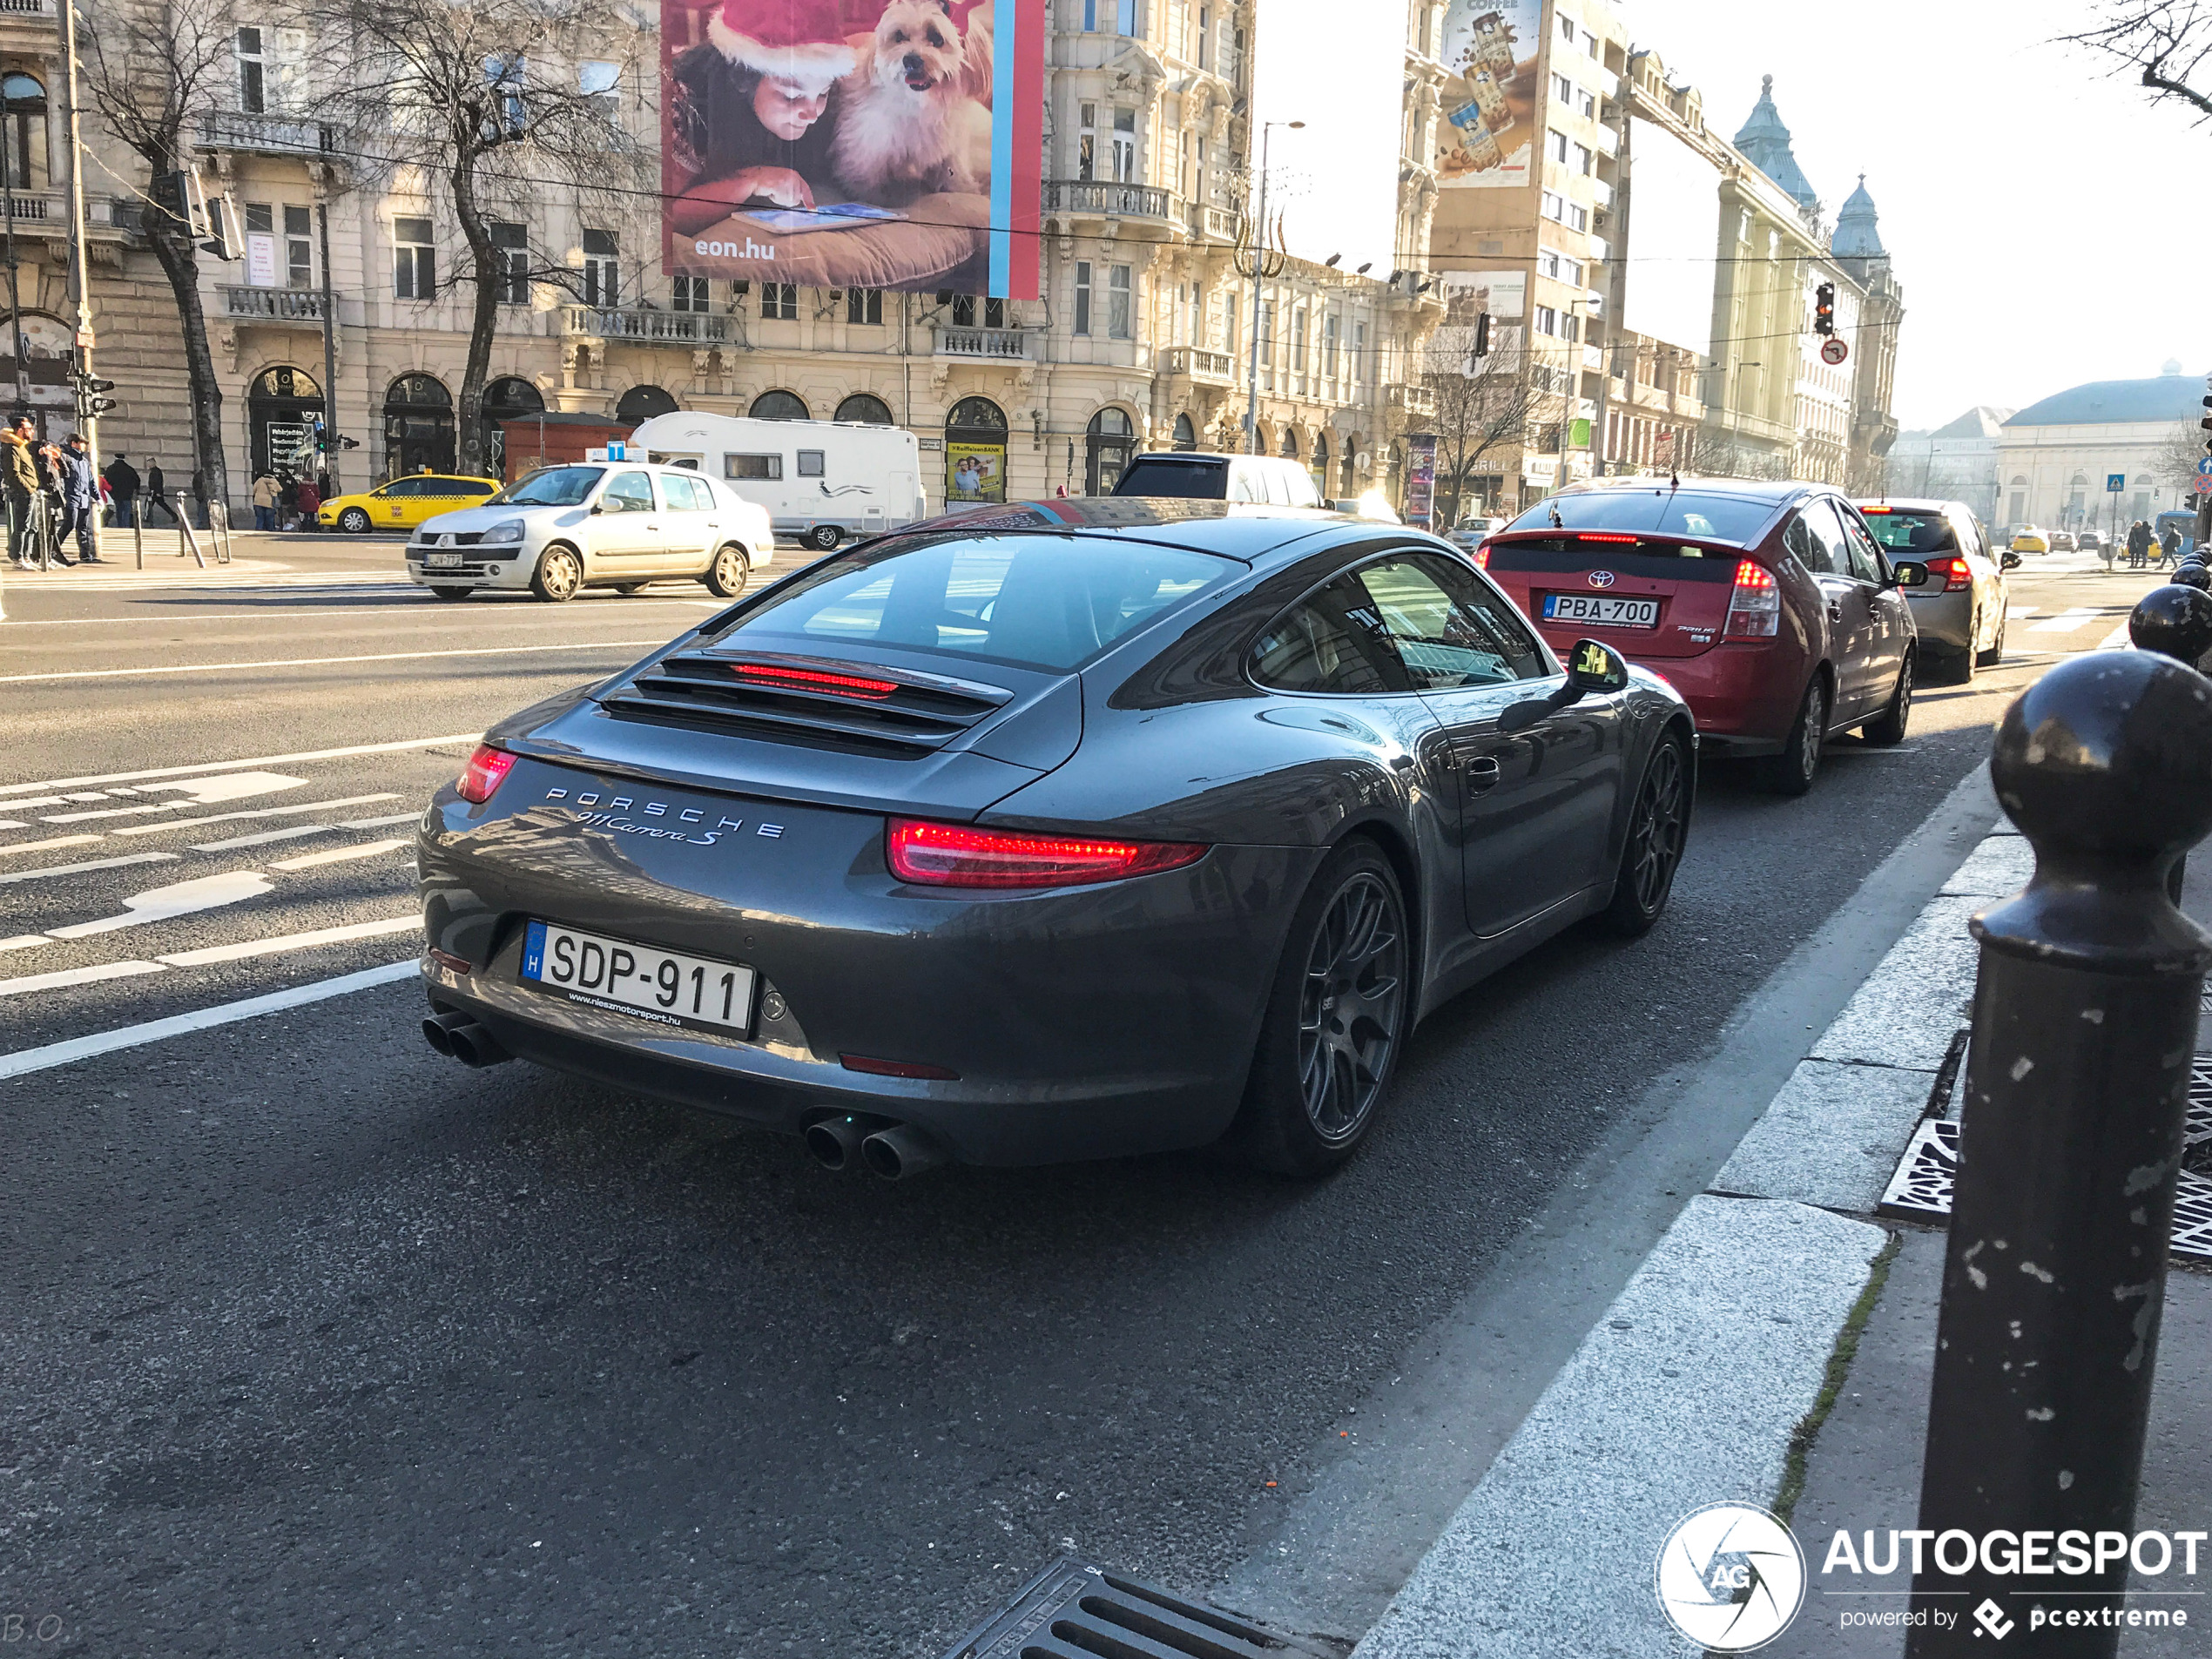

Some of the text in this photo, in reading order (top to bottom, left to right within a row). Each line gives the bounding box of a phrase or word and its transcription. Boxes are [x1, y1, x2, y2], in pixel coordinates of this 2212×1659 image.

[1467, 0, 1518, 10] COFFEE
[695, 236, 775, 260] eon.hu
[1557, 598, 1653, 622] PBA-700
[1676, 625, 1716, 634] PRIUS
[545, 787, 786, 839] PORSCHE
[687, 831, 724, 846] S
[527, 935, 736, 1020] H SDP-911
[568, 992, 681, 1027] www.nieszmotorsport.hu
